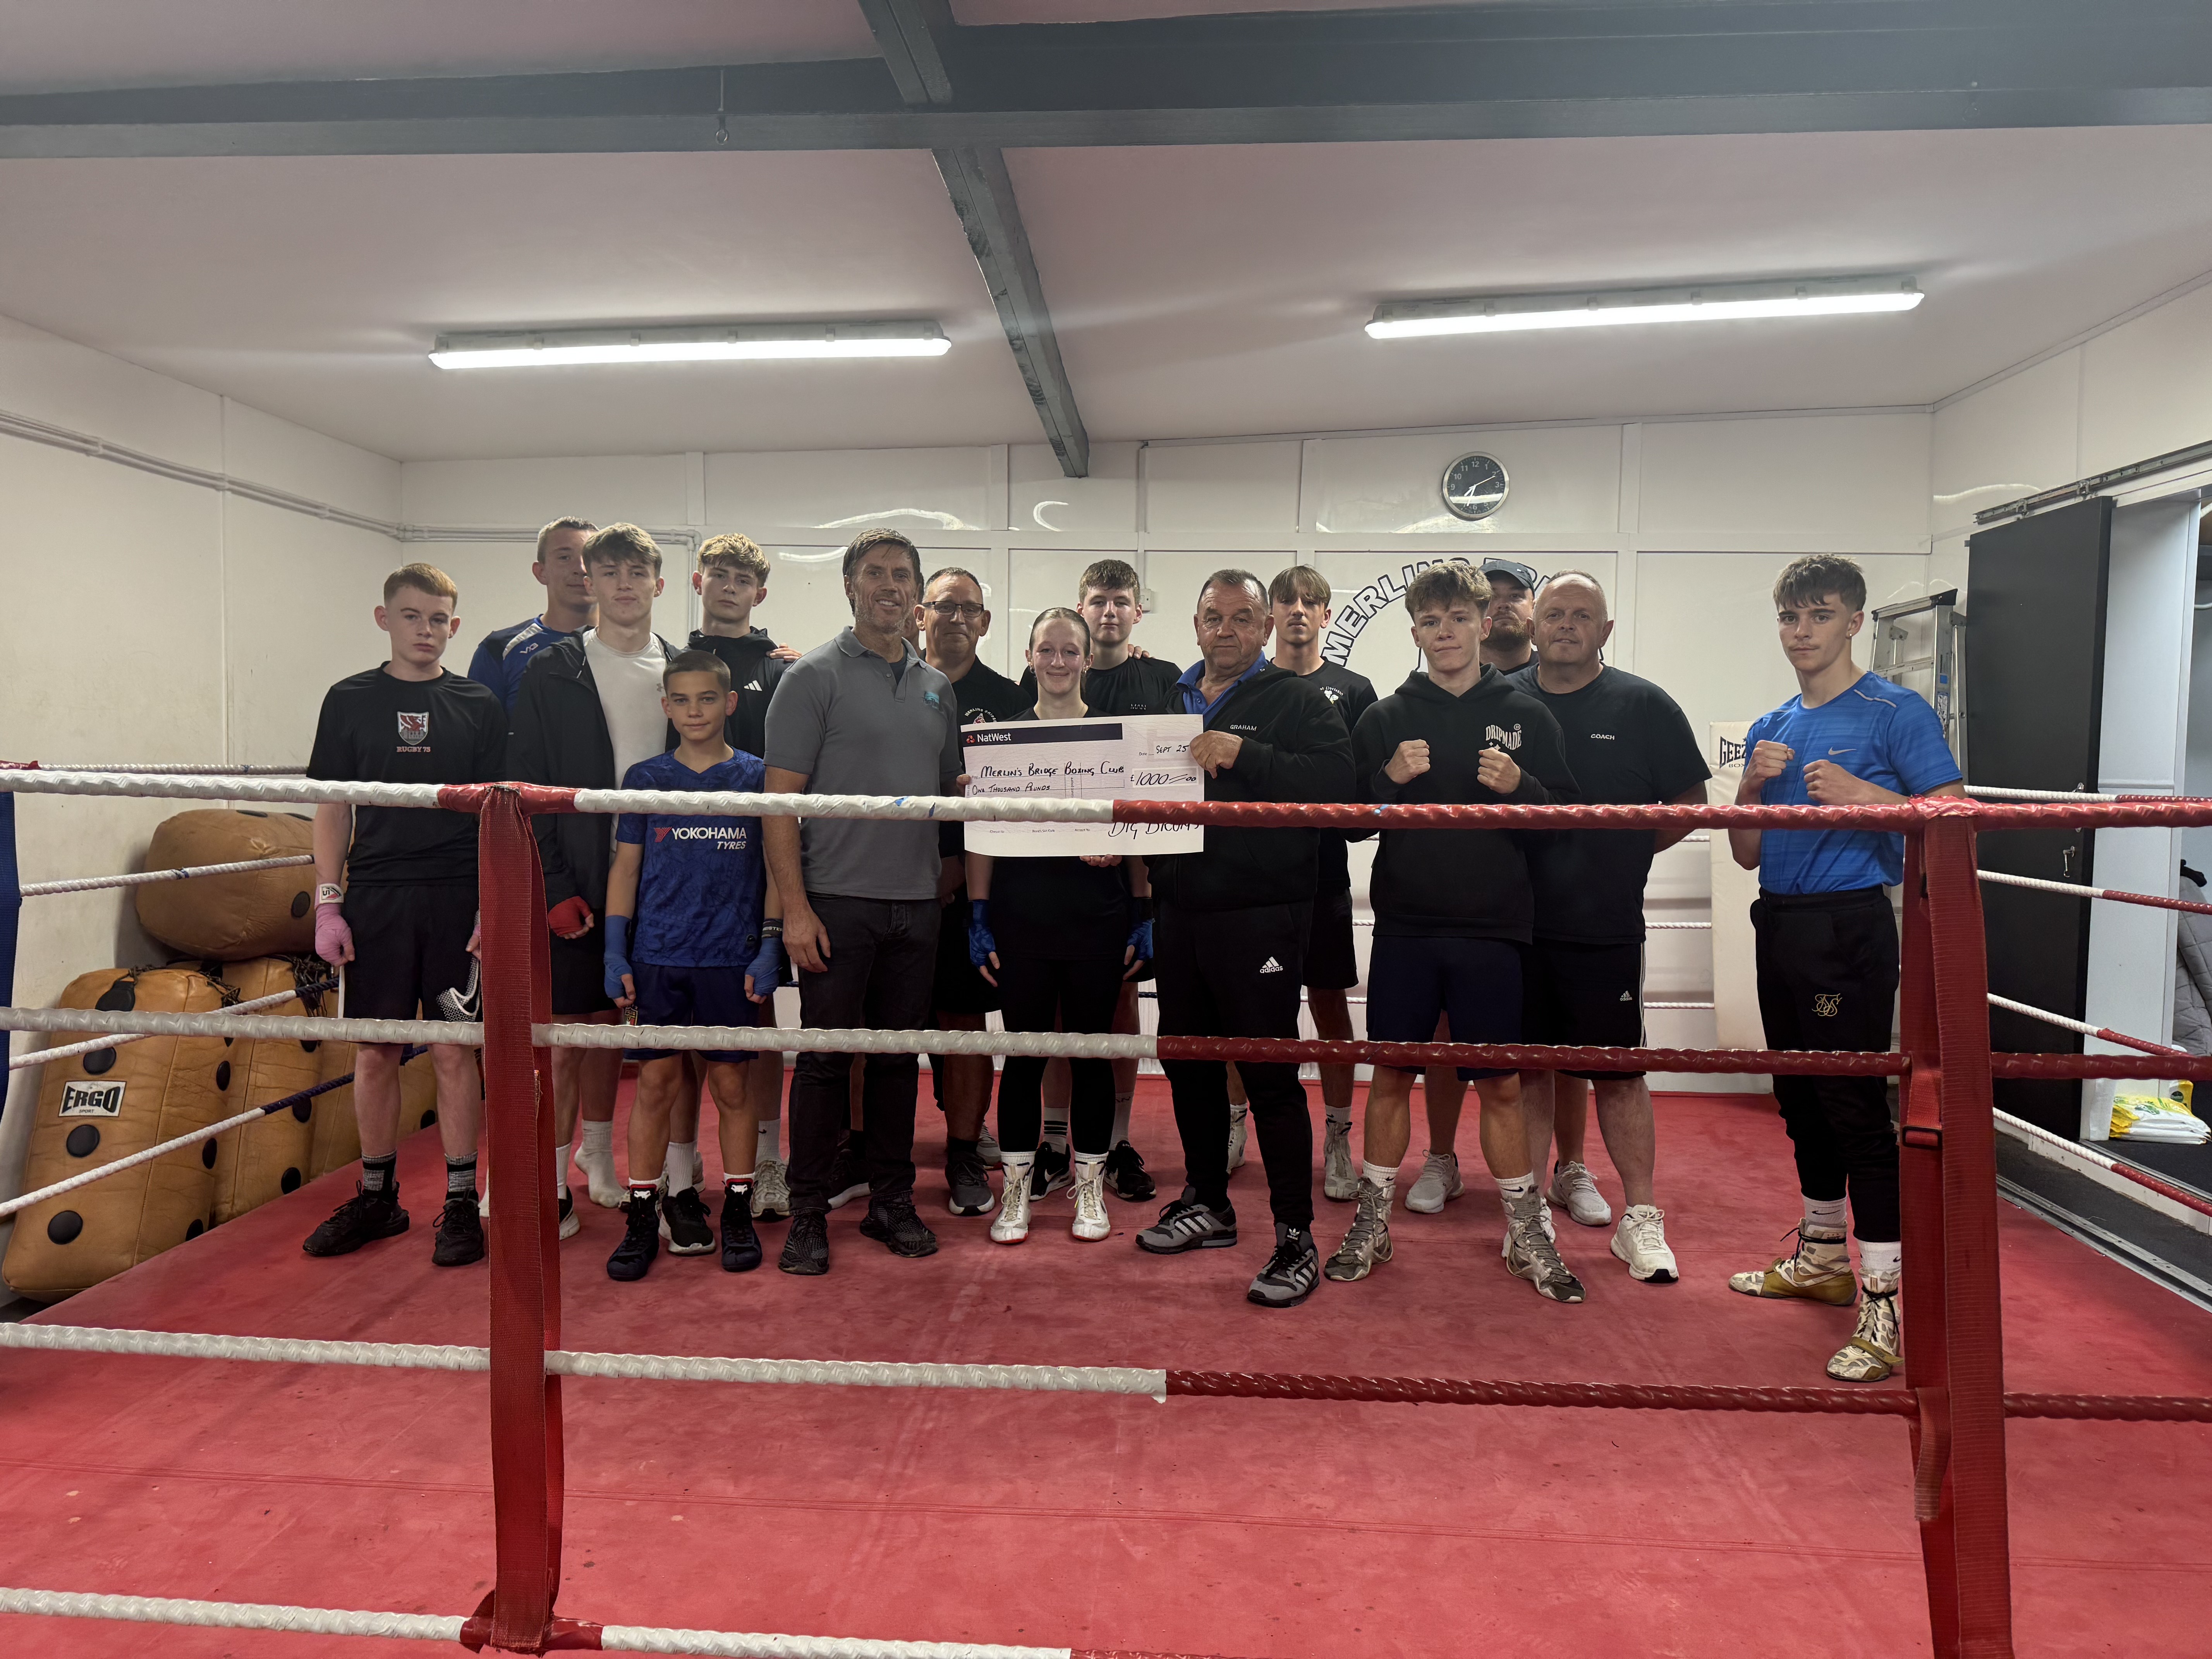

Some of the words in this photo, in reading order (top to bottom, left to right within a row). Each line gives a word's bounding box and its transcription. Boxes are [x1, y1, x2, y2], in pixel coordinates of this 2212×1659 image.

[977, 732, 1012, 743] NatWest
[1486, 725, 1522, 750] DRIPMADE
[1156, 745, 1172, 754] SEPT
[1719, 736, 1746, 769] GEEZ
[1028, 763, 1059, 777] BRIDGE
[1064, 761, 1095, 776] BOXING
[1100, 761, 1124, 774] CLUB
[672, 827, 747, 840] YOKOHAMA
[717, 841, 746, 849] TYRES
[61, 1085, 120, 1114] ERGO
